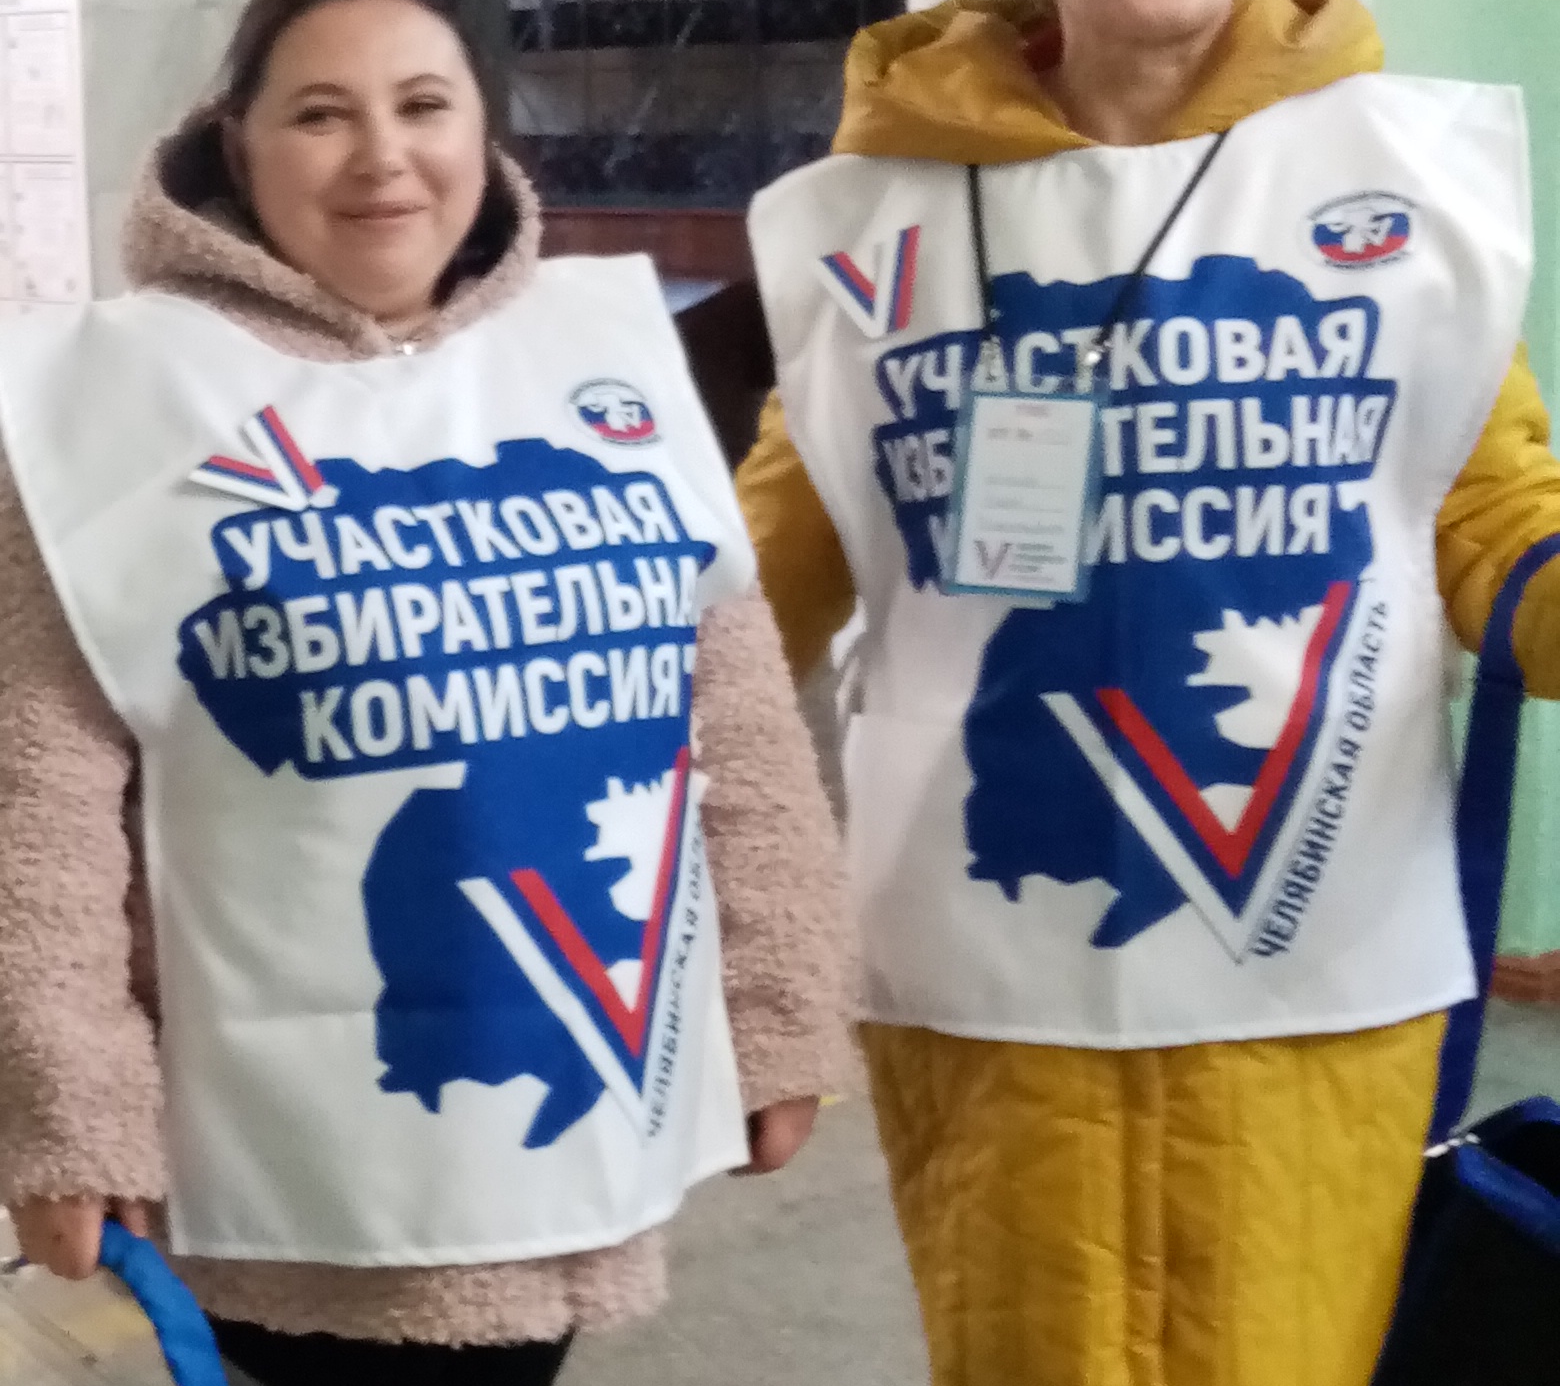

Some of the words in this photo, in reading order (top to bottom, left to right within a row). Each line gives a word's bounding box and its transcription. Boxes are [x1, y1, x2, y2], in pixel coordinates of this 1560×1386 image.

[882, 307, 1367, 419] УЧАСТКОВАЯ
[882, 393, 1388, 503] ИЗБТЕЛЬНАЯ
[222, 481, 681, 589] УЧАСТКОВАЯ
[193, 555, 701, 680] ИЗБИРАТЕЛЬНА
[300, 642, 681, 764] КОМИССИЯ
[1250, 734, 1363, 957] ЧЕЛЯБИНСКАЯ
[1345, 600, 1389, 733] ОБЛАСТЬ
